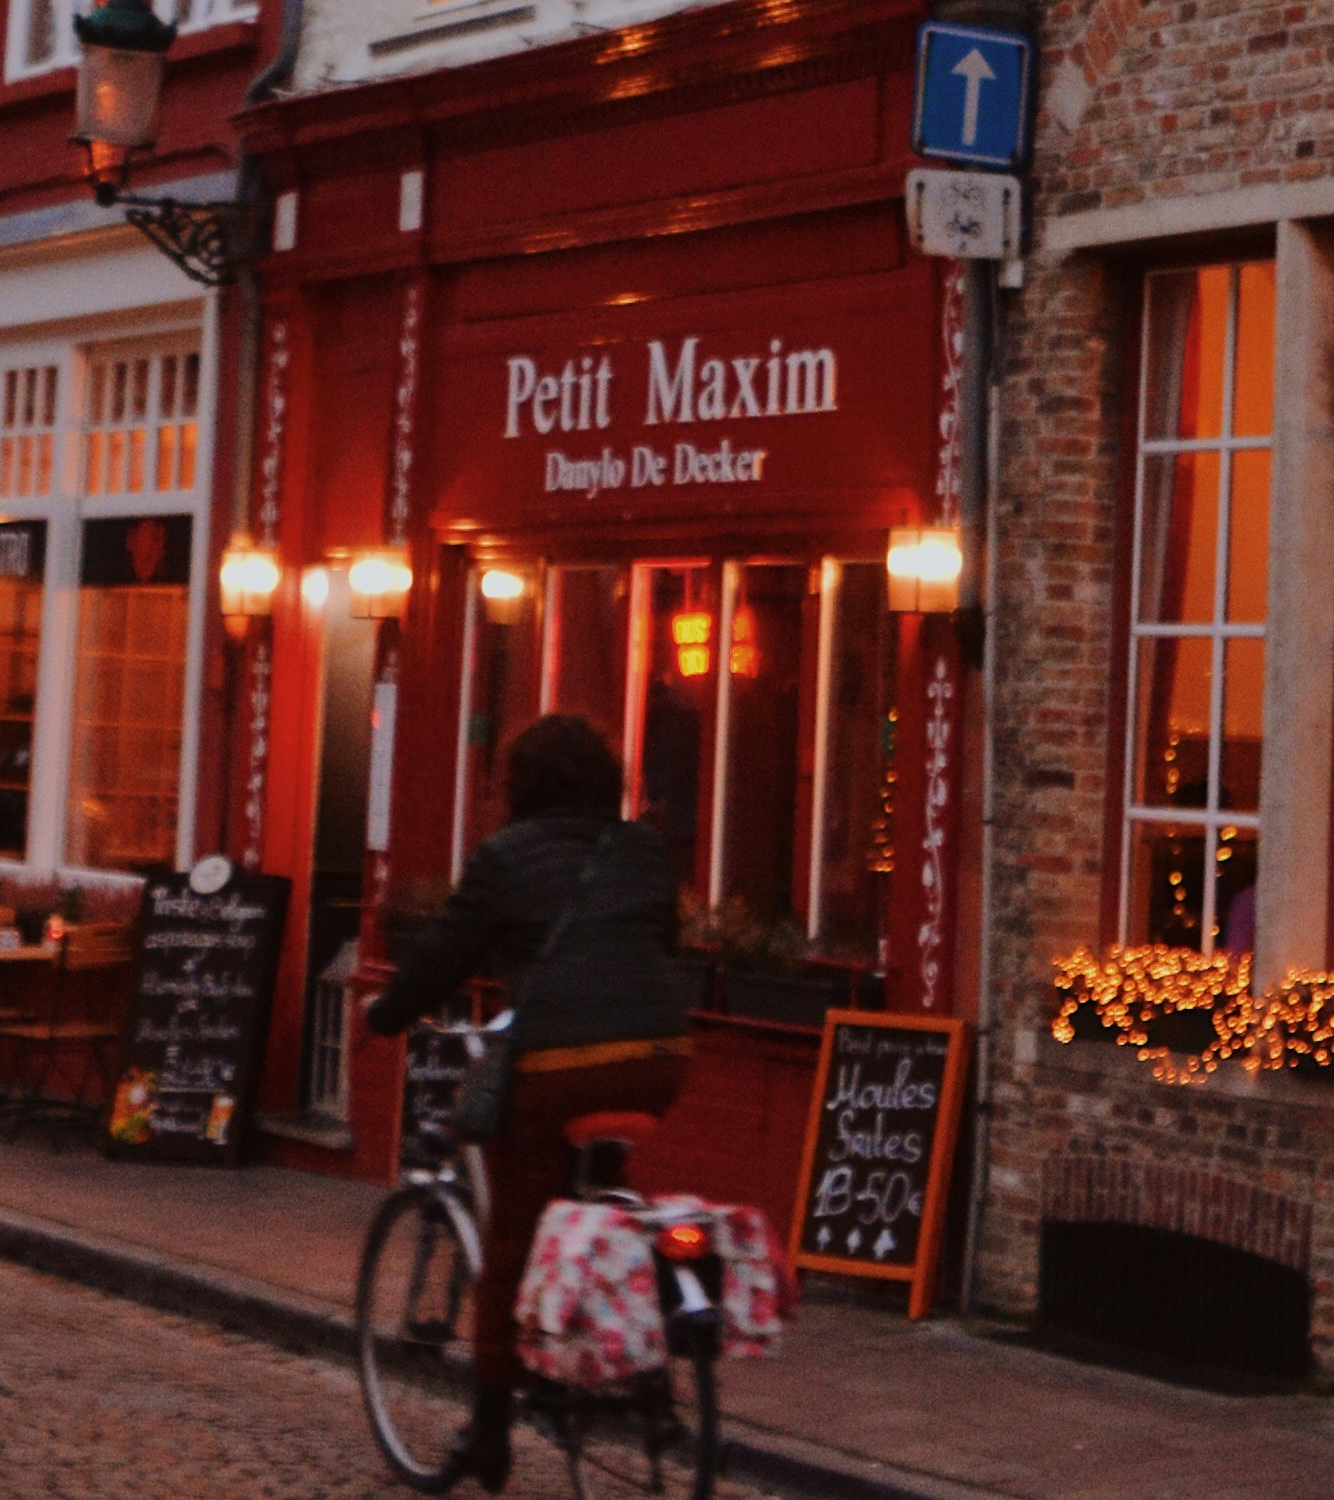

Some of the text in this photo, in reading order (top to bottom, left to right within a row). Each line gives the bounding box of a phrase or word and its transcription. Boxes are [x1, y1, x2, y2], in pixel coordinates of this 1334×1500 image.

[504, 337, 837, 438] Petit Maxim
[545, 439, 766, 499] Danylo De Decker
[826, 1057, 936, 1110] Moules
